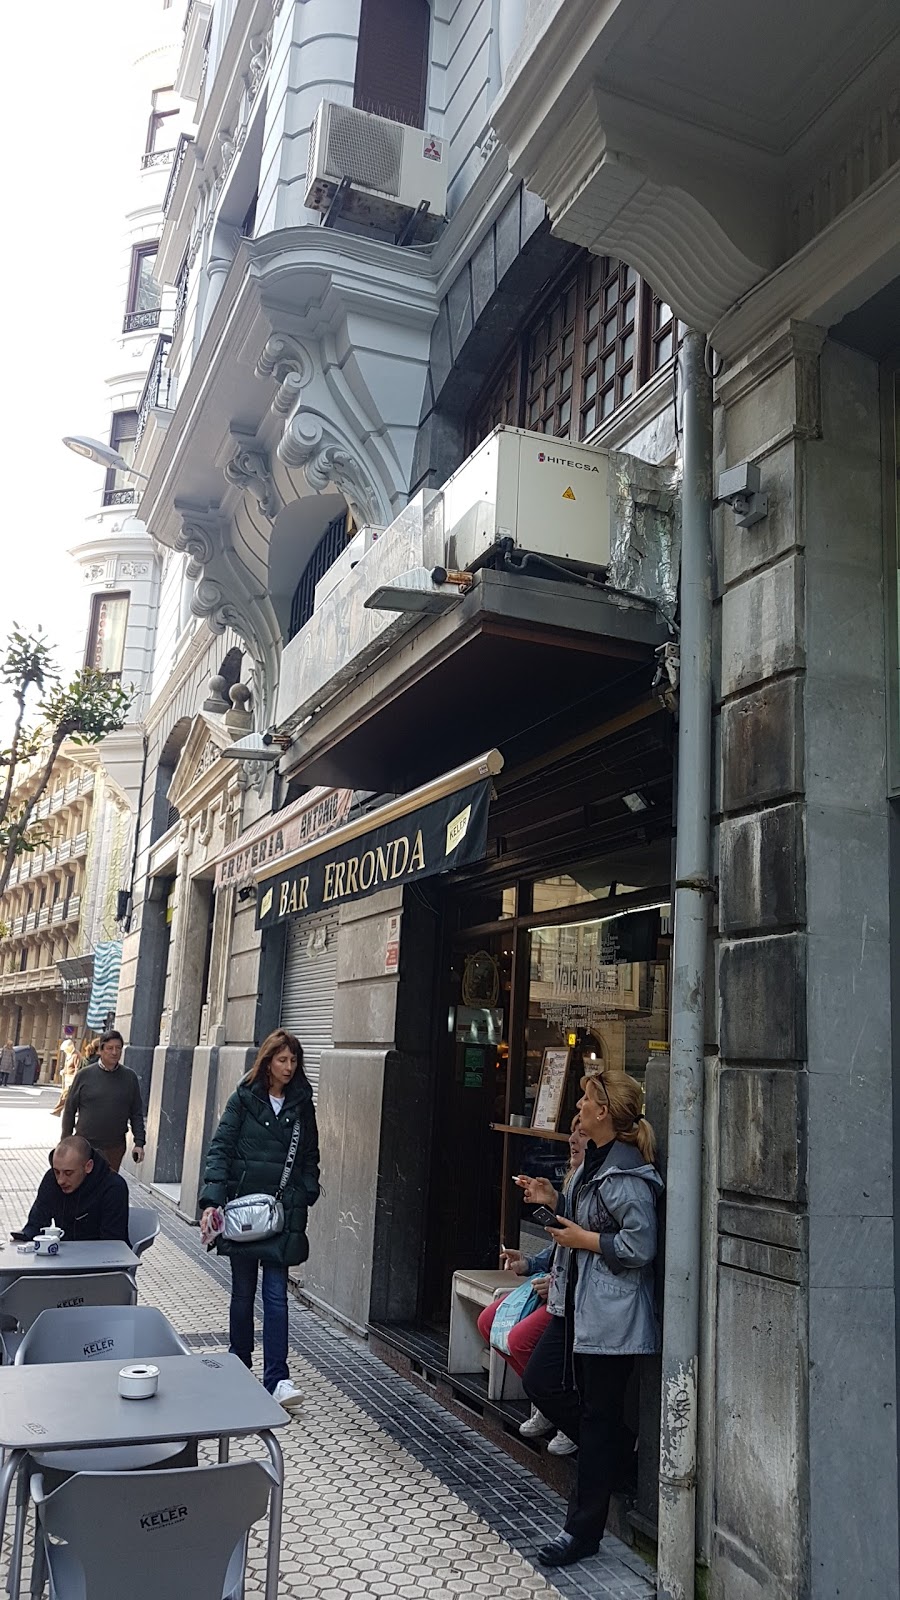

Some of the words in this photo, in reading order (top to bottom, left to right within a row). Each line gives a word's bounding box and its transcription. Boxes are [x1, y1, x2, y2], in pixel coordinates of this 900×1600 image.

[547, 456, 600, 473] HITECSA
[449, 817, 467, 841] KELER
[278, 875, 310, 917] BAR
[322, 829, 426, 903] ERRONDA
[555, 965, 600, 994] Welcome
[56, 1297, 85, 1308] KELER
[83, 1339, 115, 1355] KELER
[139, 1506, 188, 1529] KELER
